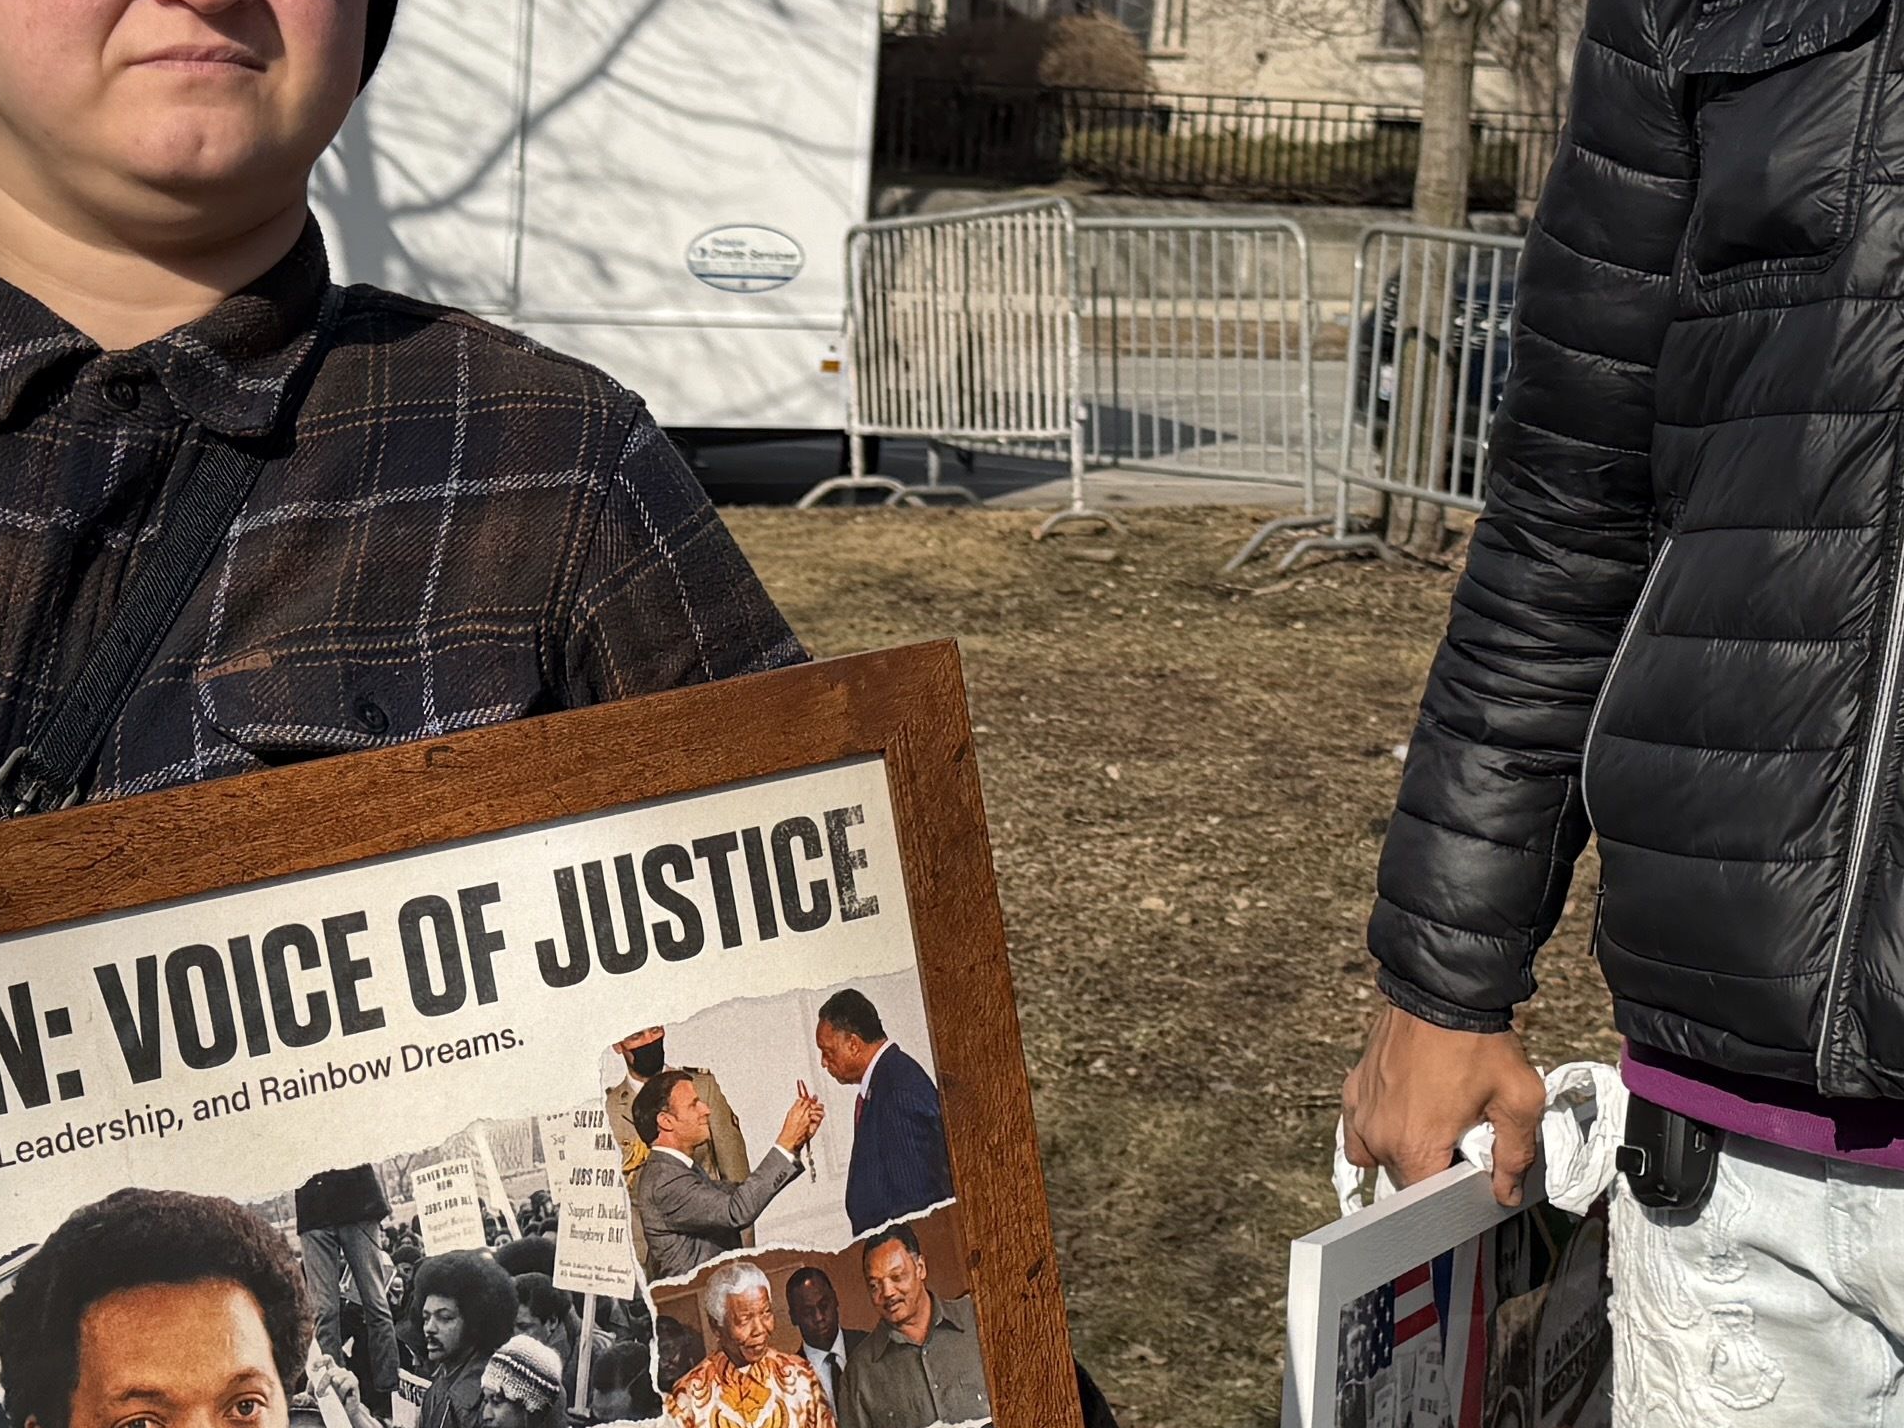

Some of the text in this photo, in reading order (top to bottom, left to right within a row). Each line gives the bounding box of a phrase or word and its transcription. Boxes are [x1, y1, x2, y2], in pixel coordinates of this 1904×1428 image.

[93, 910, 385, 1084] VOICE
[398, 882, 505, 1016] OF
[534, 804, 879, 987] JUSTICE
[192, 1081, 250, 1121] and
[259, 1055, 391, 1105] Rainbow
[400, 1028, 523, 1072] Dreams.
